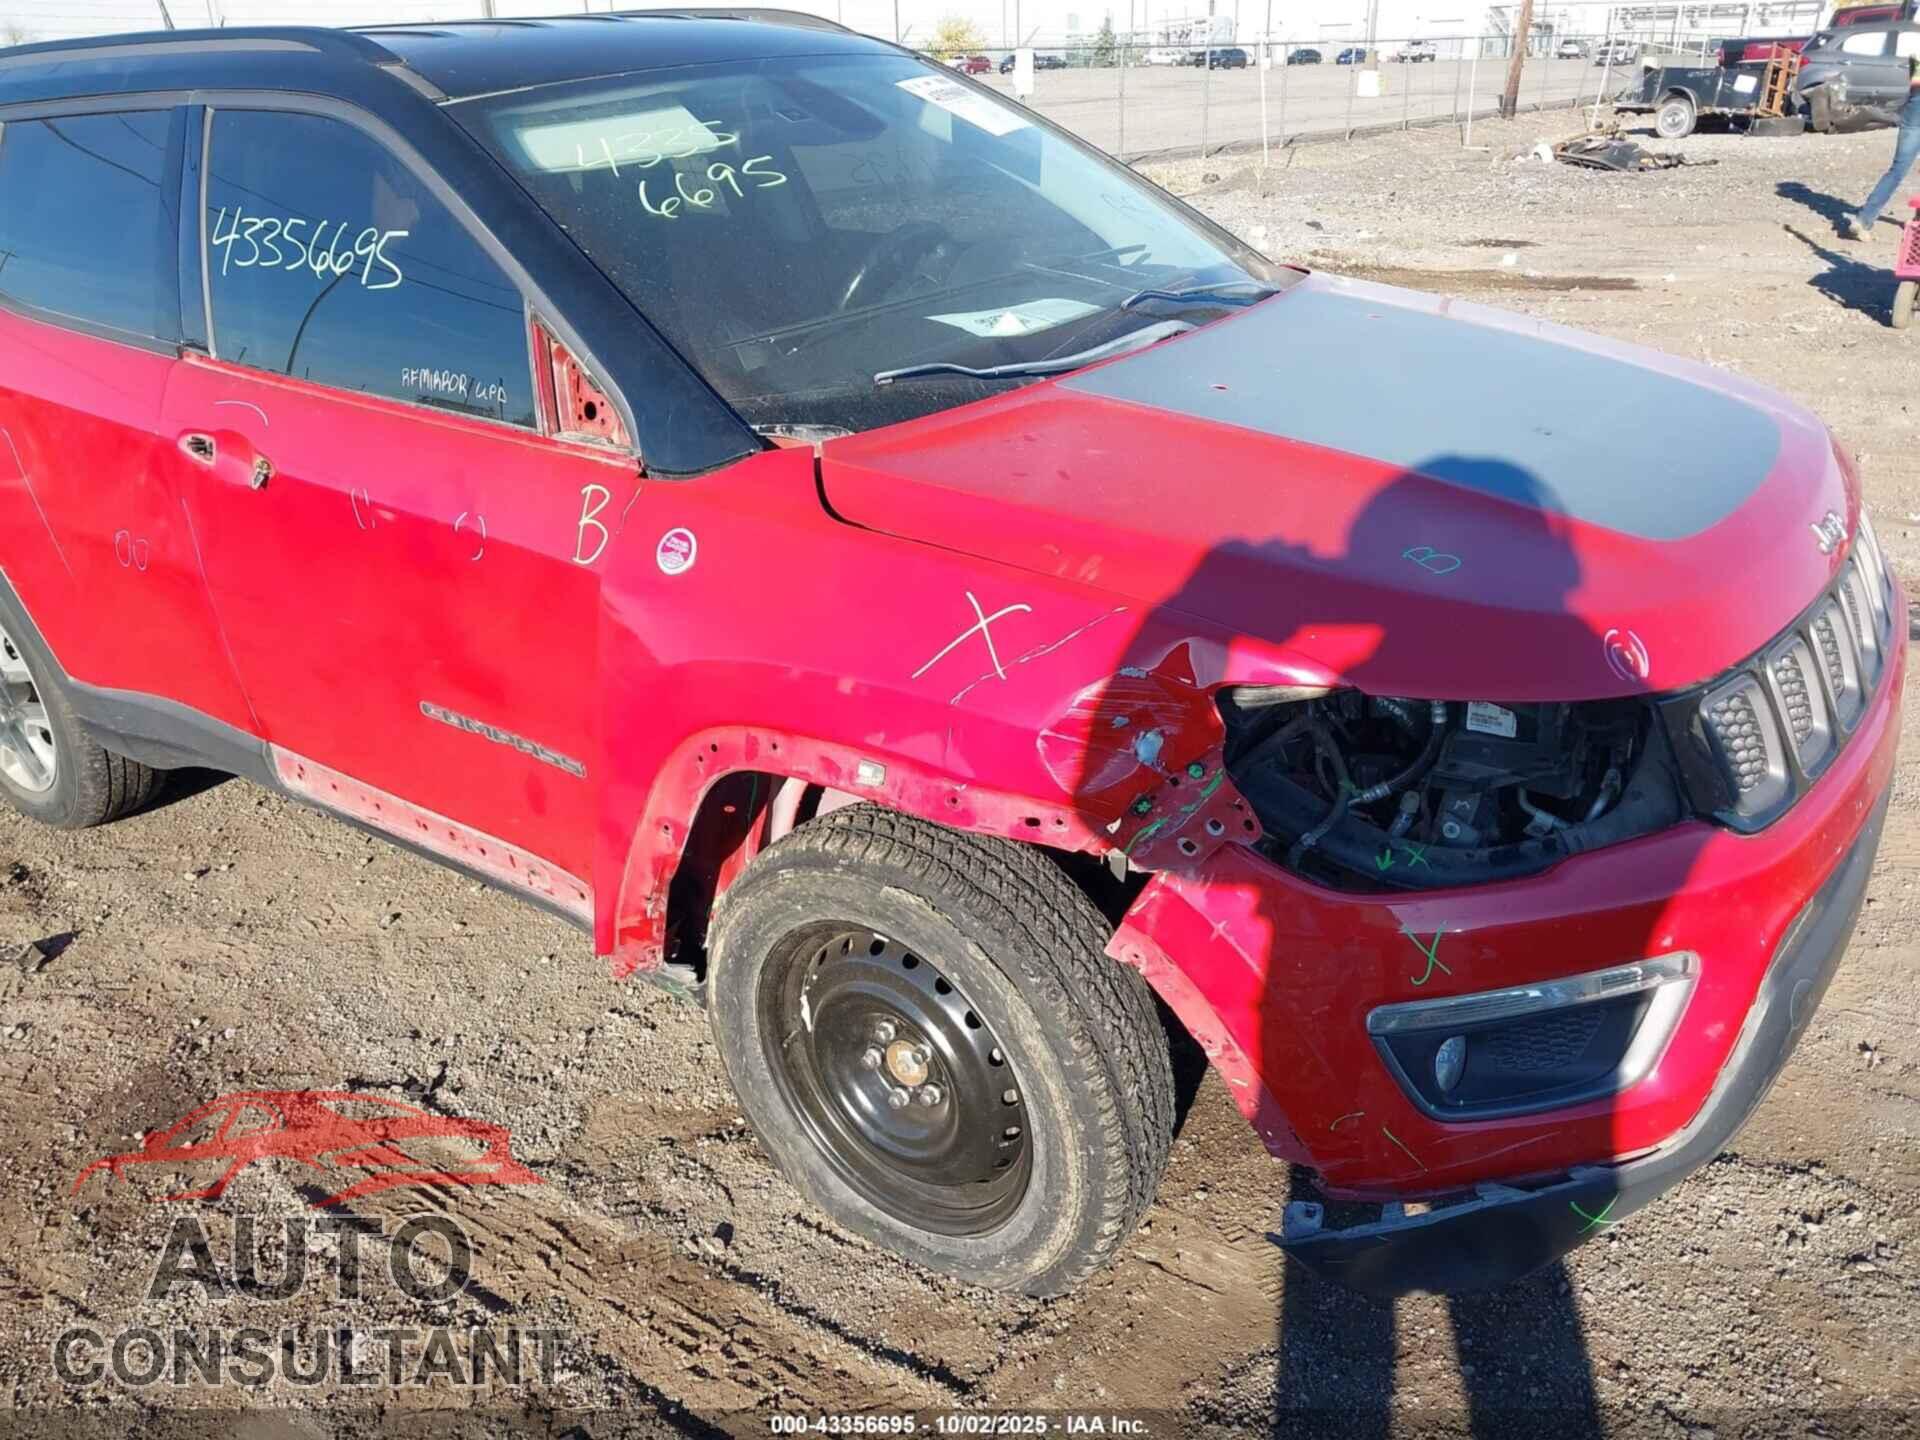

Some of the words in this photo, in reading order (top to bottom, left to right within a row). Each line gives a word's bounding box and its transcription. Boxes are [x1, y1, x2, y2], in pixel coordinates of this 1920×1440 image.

[575, 120, 738, 178] 4335
[638, 155, 788, 219] 6695
[212, 206, 409, 290] 43356695
[572, 483, 611, 565] B
